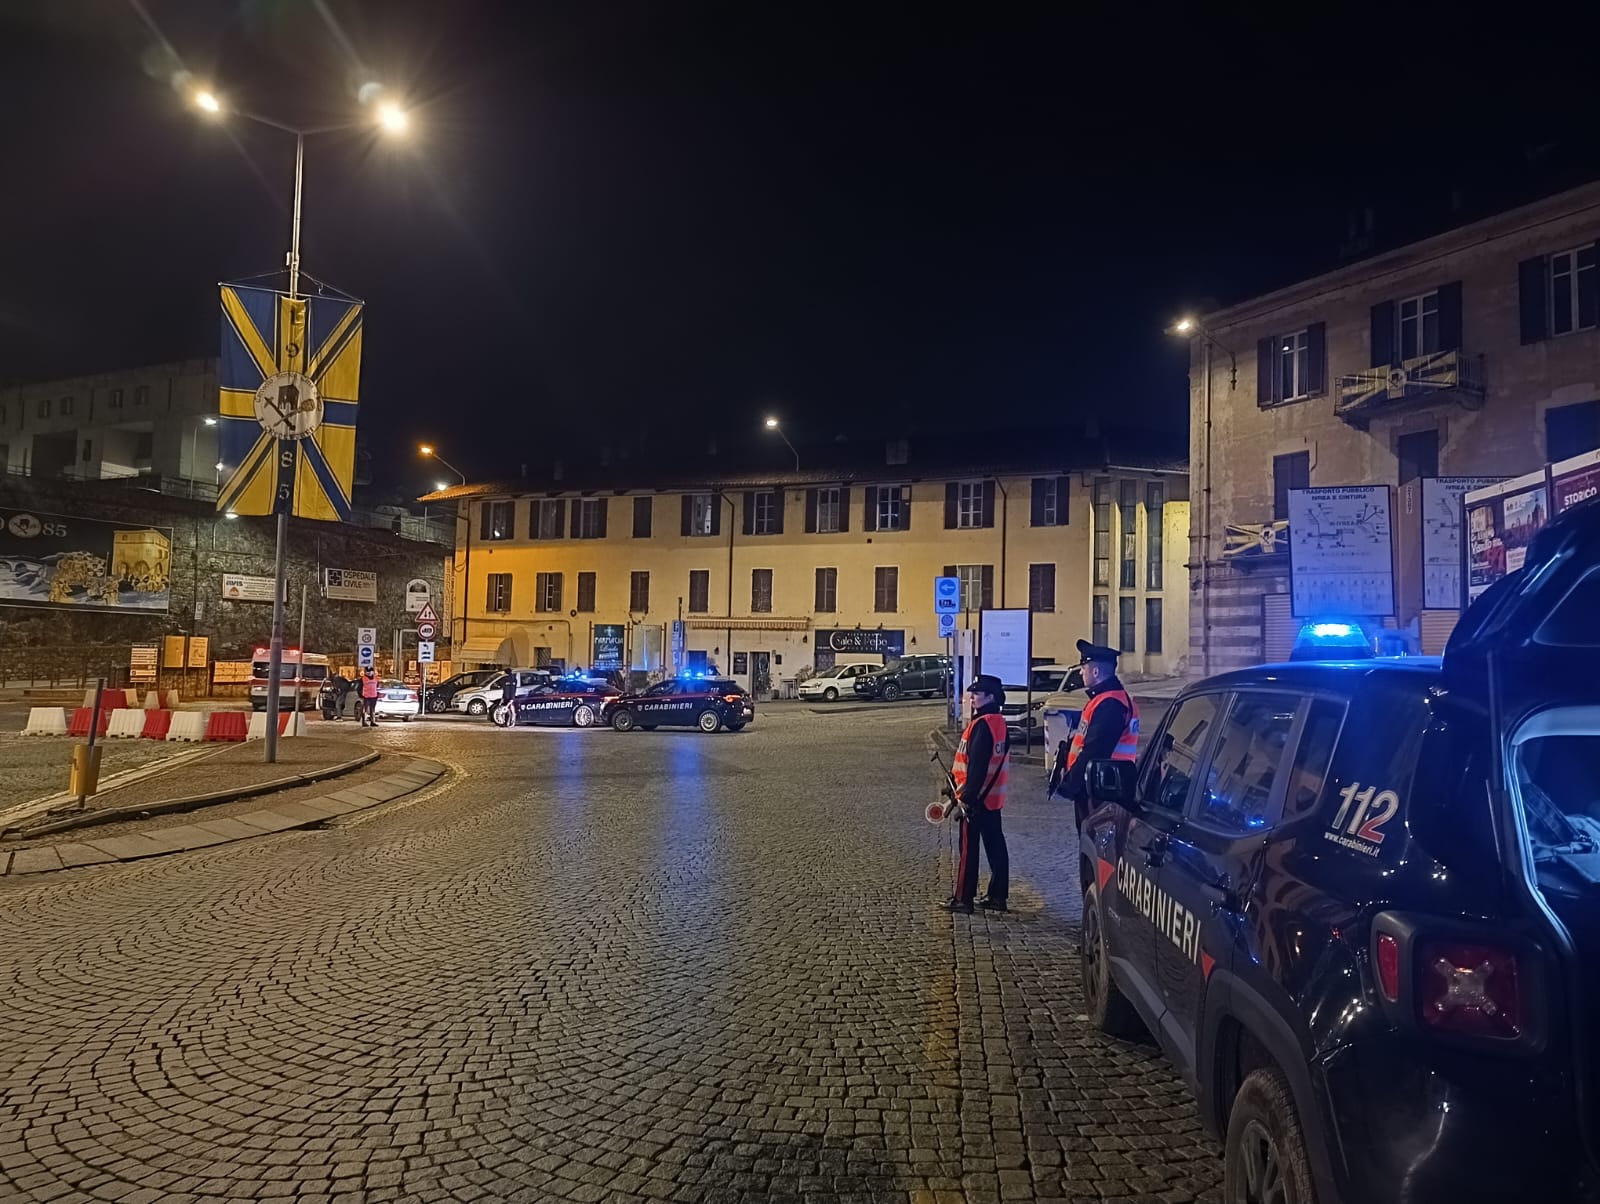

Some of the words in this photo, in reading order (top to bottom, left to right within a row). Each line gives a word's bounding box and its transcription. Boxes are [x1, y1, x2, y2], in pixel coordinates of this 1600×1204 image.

[1564, 486, 1598, 506] STORICO
[42, 522, 68, 538] 85
[344, 571, 375, 580] OSPEDALE
[344, 580, 362, 589] CIVILE
[854, 636, 861, 646] &
[526, 701, 574, 710] CARABINIERI
[644, 703, 693, 711] CARABINIERI
[1332, 782, 1399, 844] 112
[1323, 831, 1380, 857] www.carabinieri.it
[1116, 856, 1201, 965] CARABINIERI
